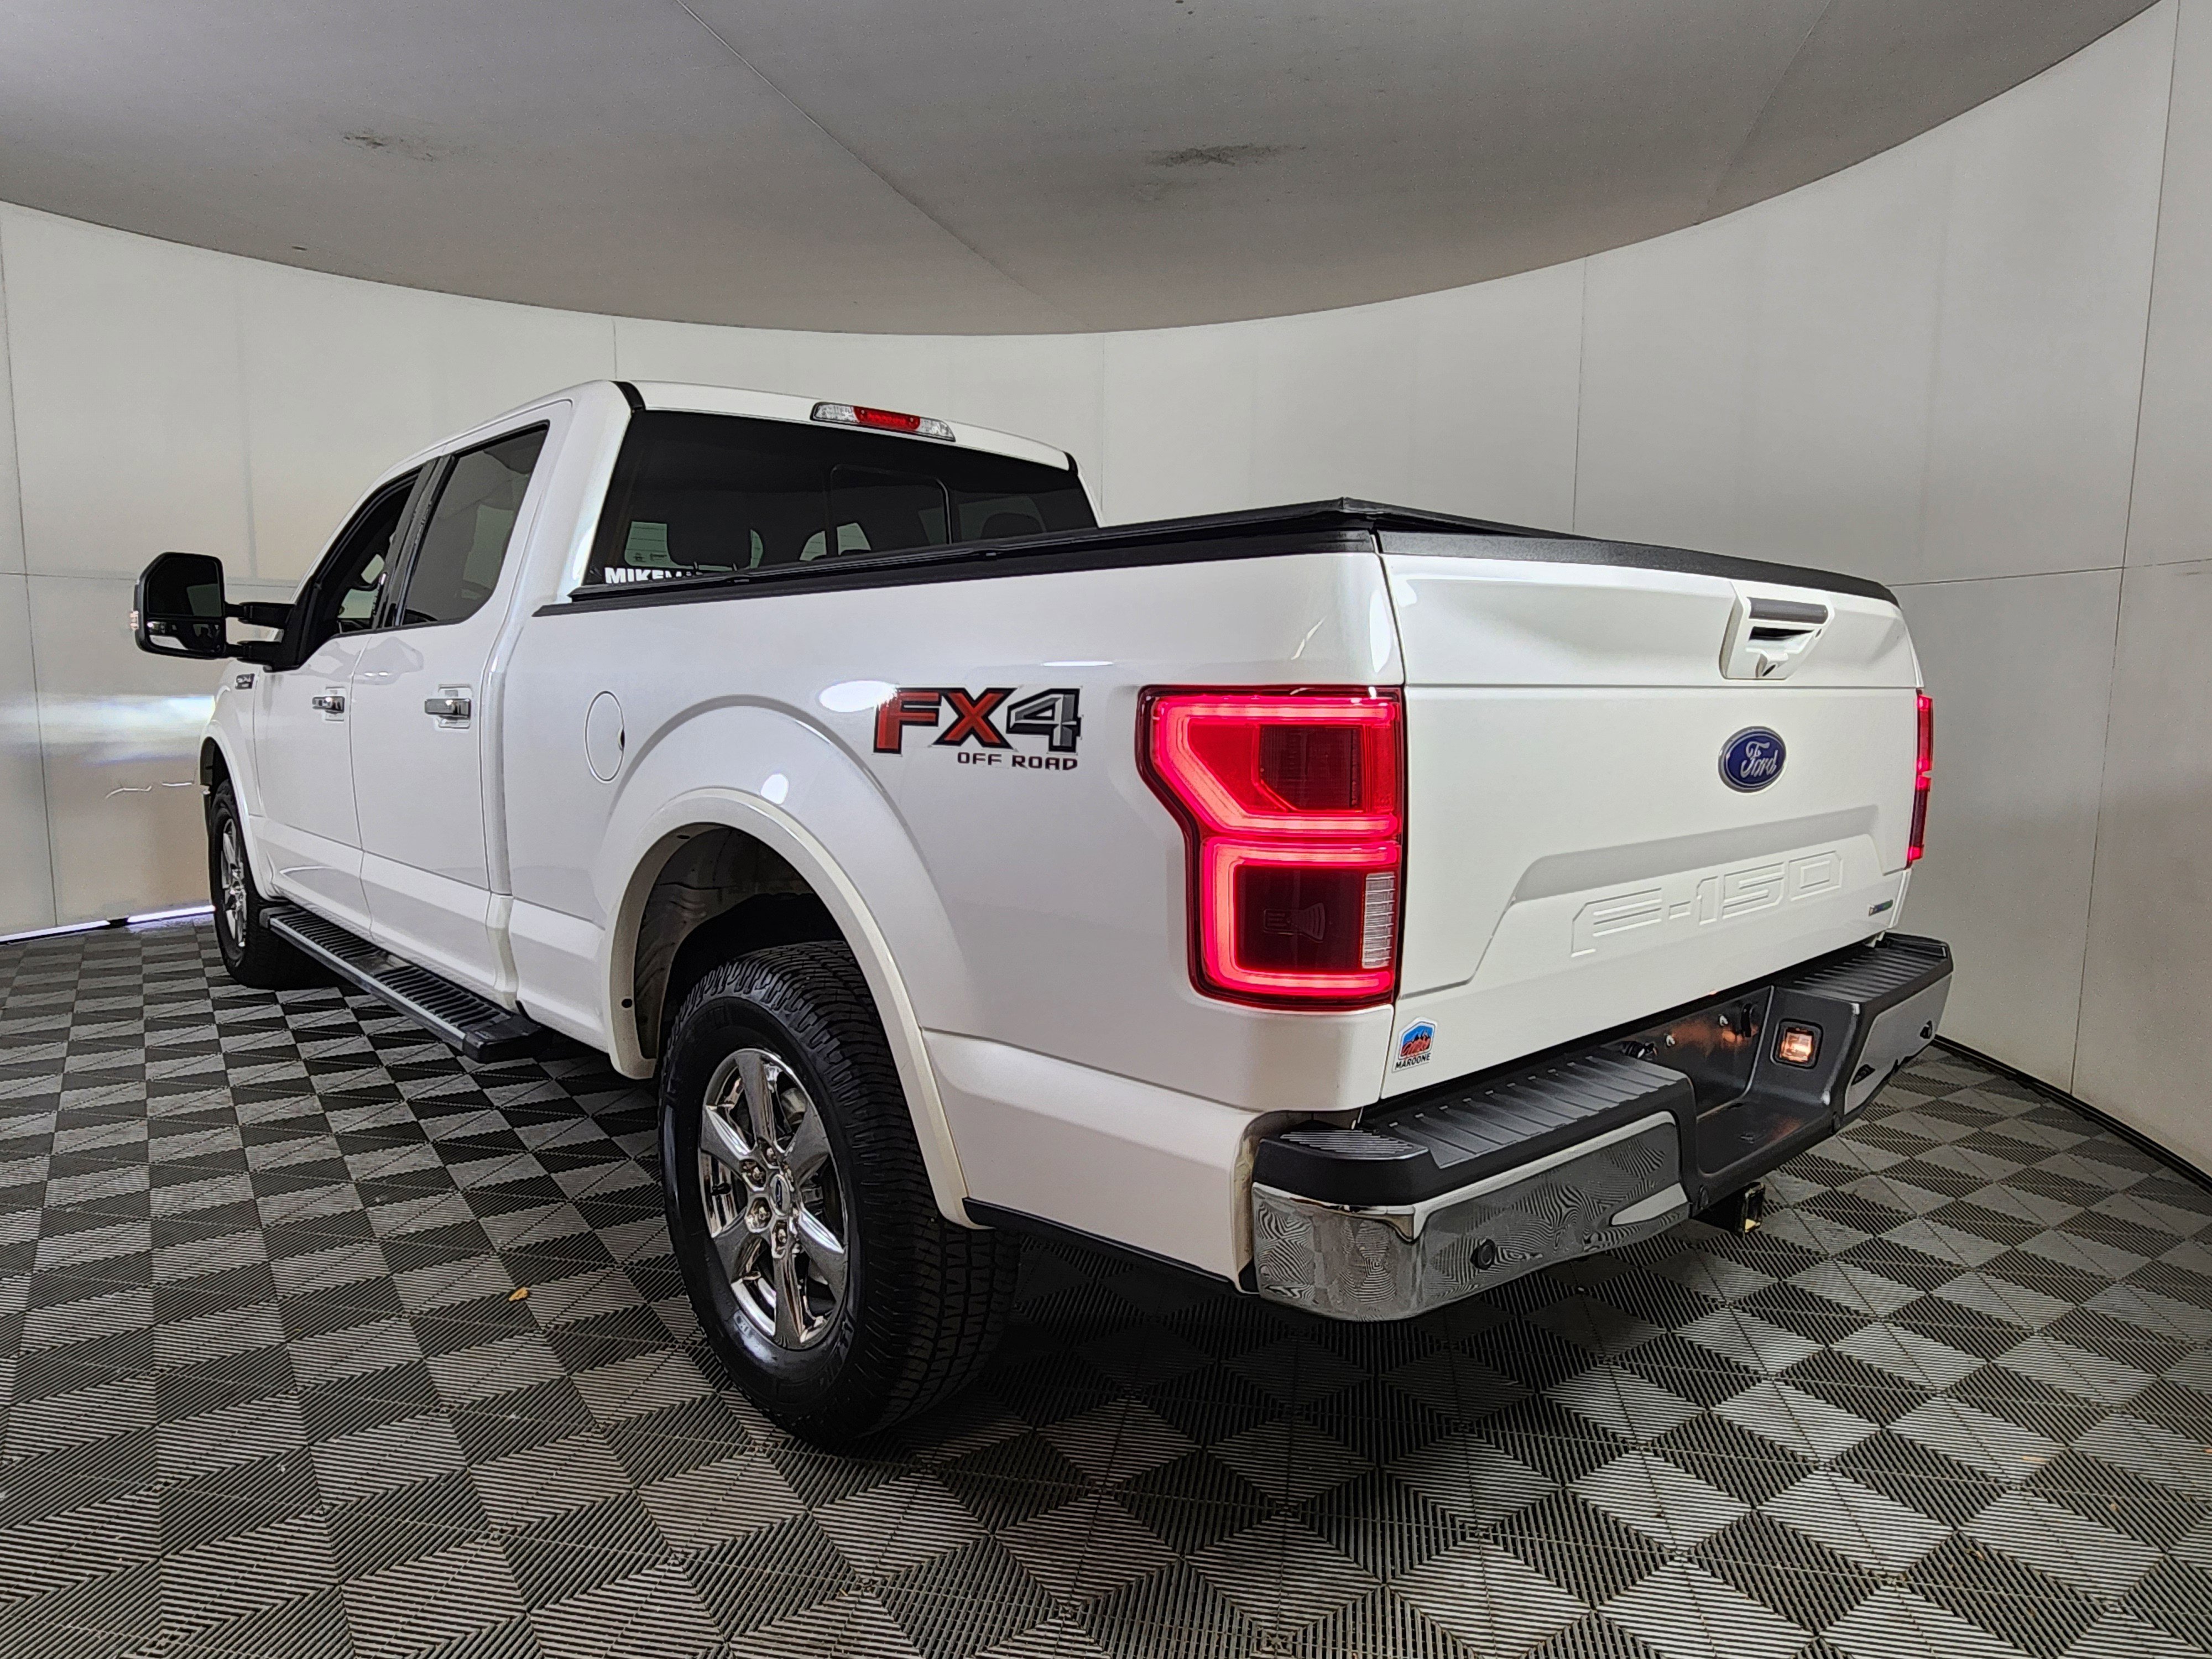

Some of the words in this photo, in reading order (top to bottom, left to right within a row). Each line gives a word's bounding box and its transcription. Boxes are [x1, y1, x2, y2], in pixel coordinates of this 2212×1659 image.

[873, 687, 1081, 753] FX4
[957, 752, 1002, 765] OFF
[1011, 754, 1078, 771] ROAD
[1740, 740, 1778, 779] Ford
[1571, 850, 1843, 958] F-150
[1395, 1052, 1431, 1071] MAROONE
